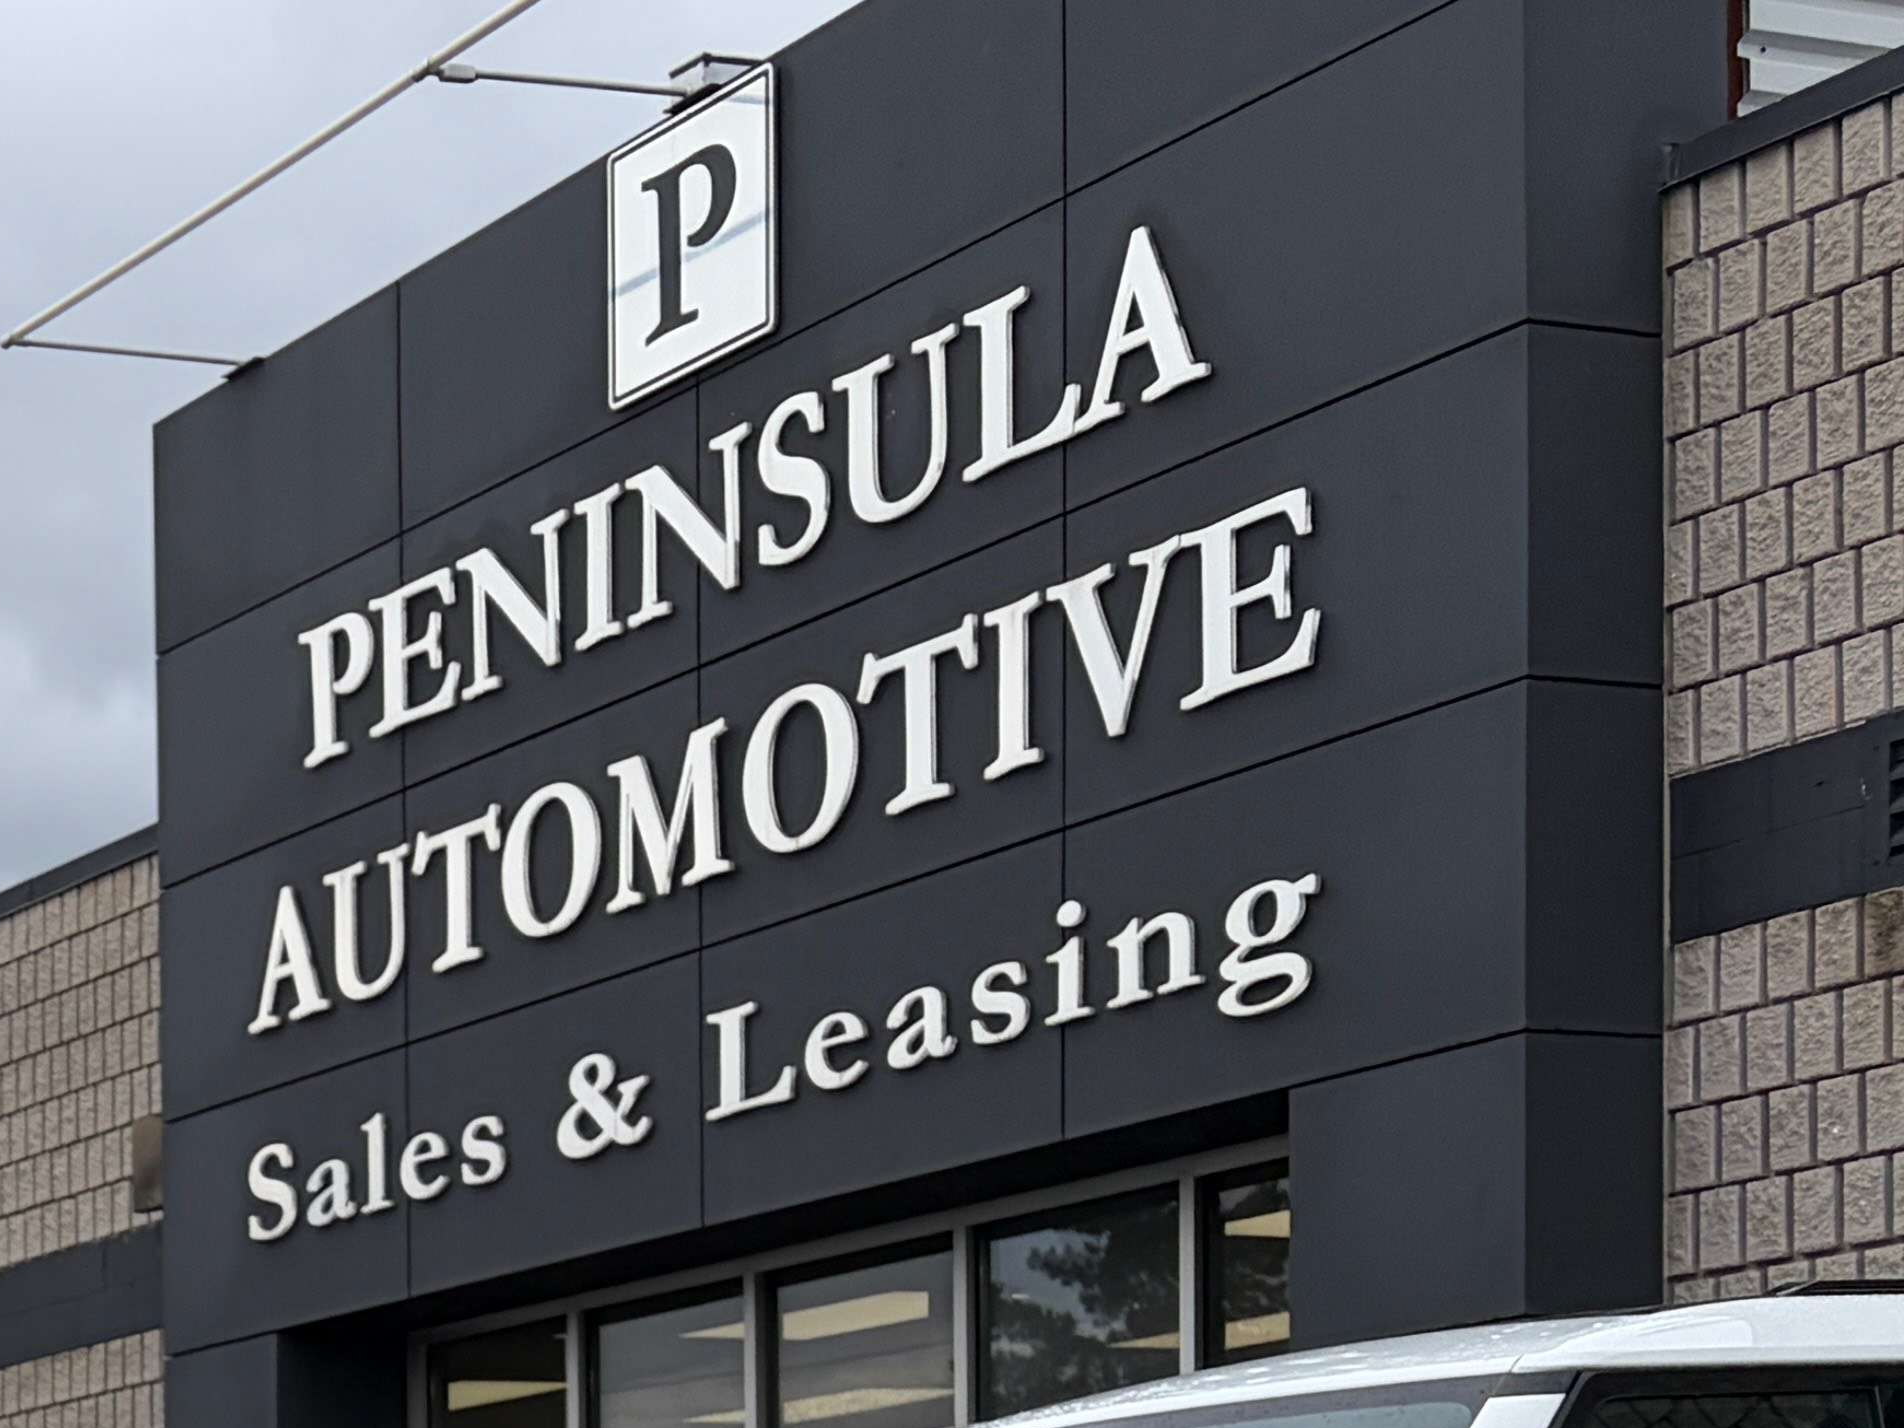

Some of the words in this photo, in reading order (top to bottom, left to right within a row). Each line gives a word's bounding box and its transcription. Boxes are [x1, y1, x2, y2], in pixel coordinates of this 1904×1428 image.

[640, 141, 739, 348] P
[297, 225, 1210, 771] PENINSULA
[246, 485, 1322, 1036] AUTOMOTIVE
[247, 1109, 506, 1242] Sales
[554, 1051, 651, 1161] &
[704, 872, 1320, 1122] Leasing
